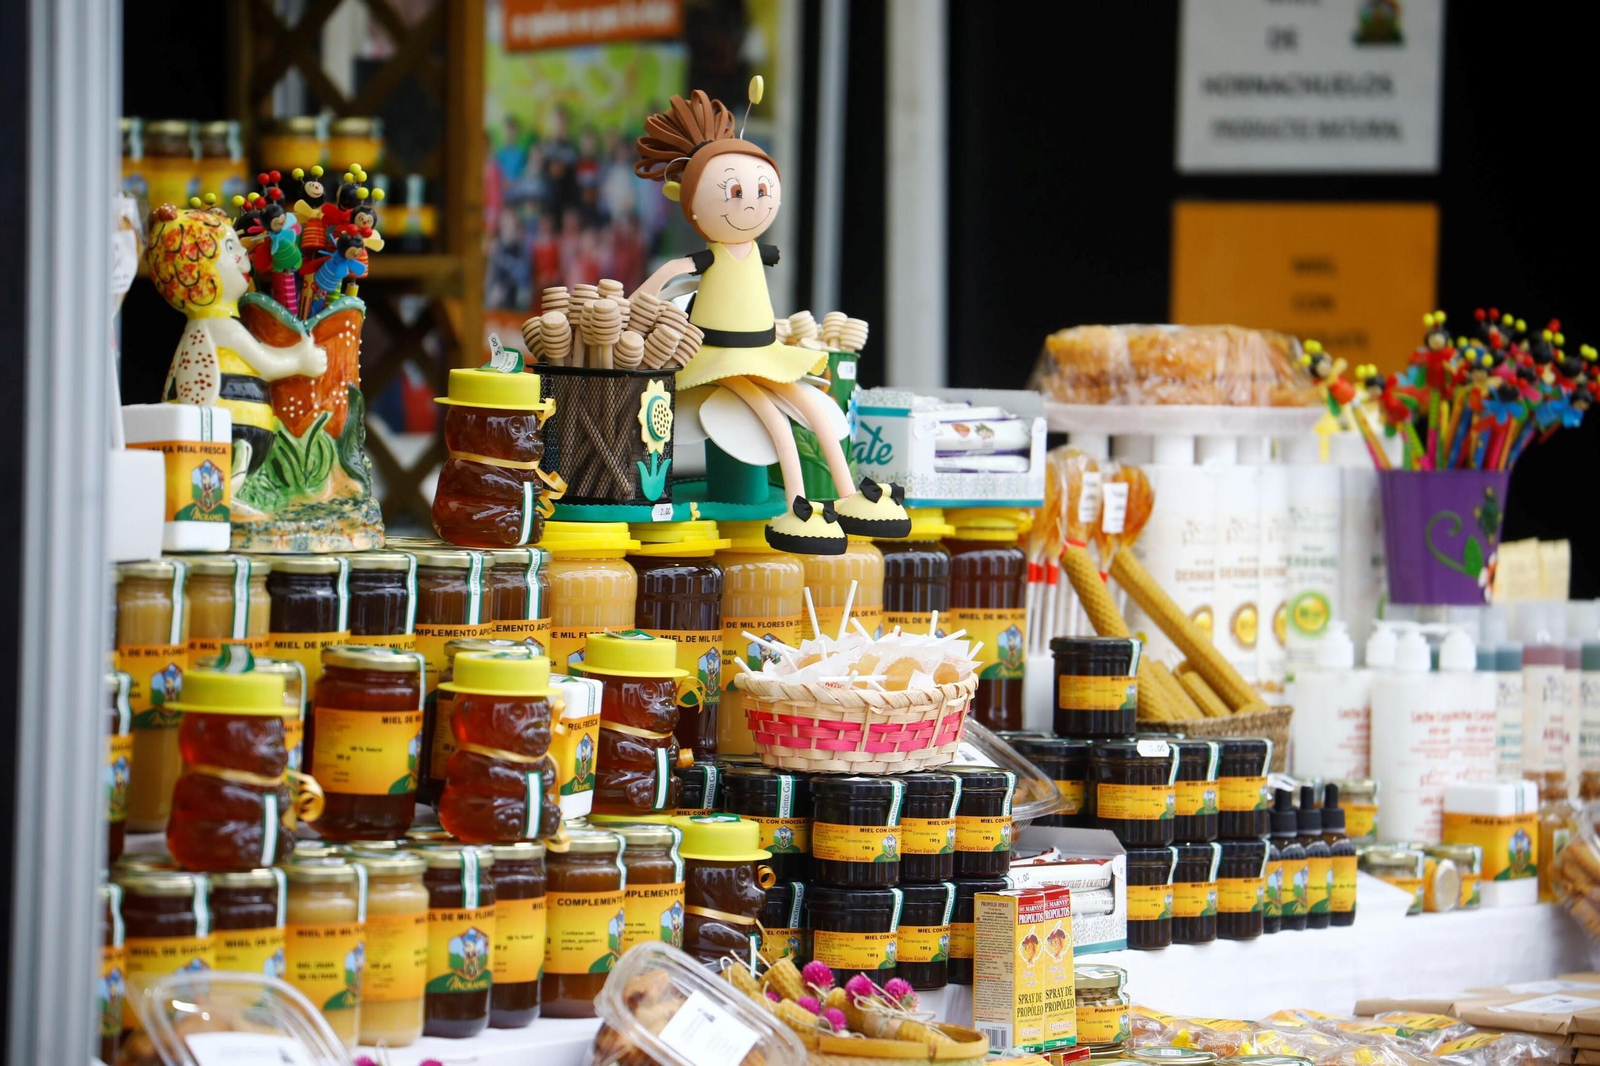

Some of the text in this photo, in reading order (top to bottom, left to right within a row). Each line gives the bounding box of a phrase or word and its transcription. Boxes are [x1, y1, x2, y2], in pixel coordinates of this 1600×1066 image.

[176, 445, 227, 455] REAL FRESCA
[726, 621, 738, 629] DE
[740, 621, 755, 629] MIL
[757, 620, 785, 628] FLORES
[887, 616, 922, 624] MIEL DE
[415, 628, 477, 637] MPLEMENTO
[685, 635, 696, 643] DE
[698, 634, 710, 642] MIL
[274, 640, 301, 650] MIEL
[303, 641, 317, 649] DE
[381, 715, 403, 725] MIEL
[457, 912, 473, 921] MIL
[1017, 992, 1043, 1004] SPRAY DE
[1045, 986, 1073, 1000] SPRAY DE
[1044, 998, 1074, 1013] PROPÓLEO
[1017, 1004, 1043, 1018] PROPÓLEO
